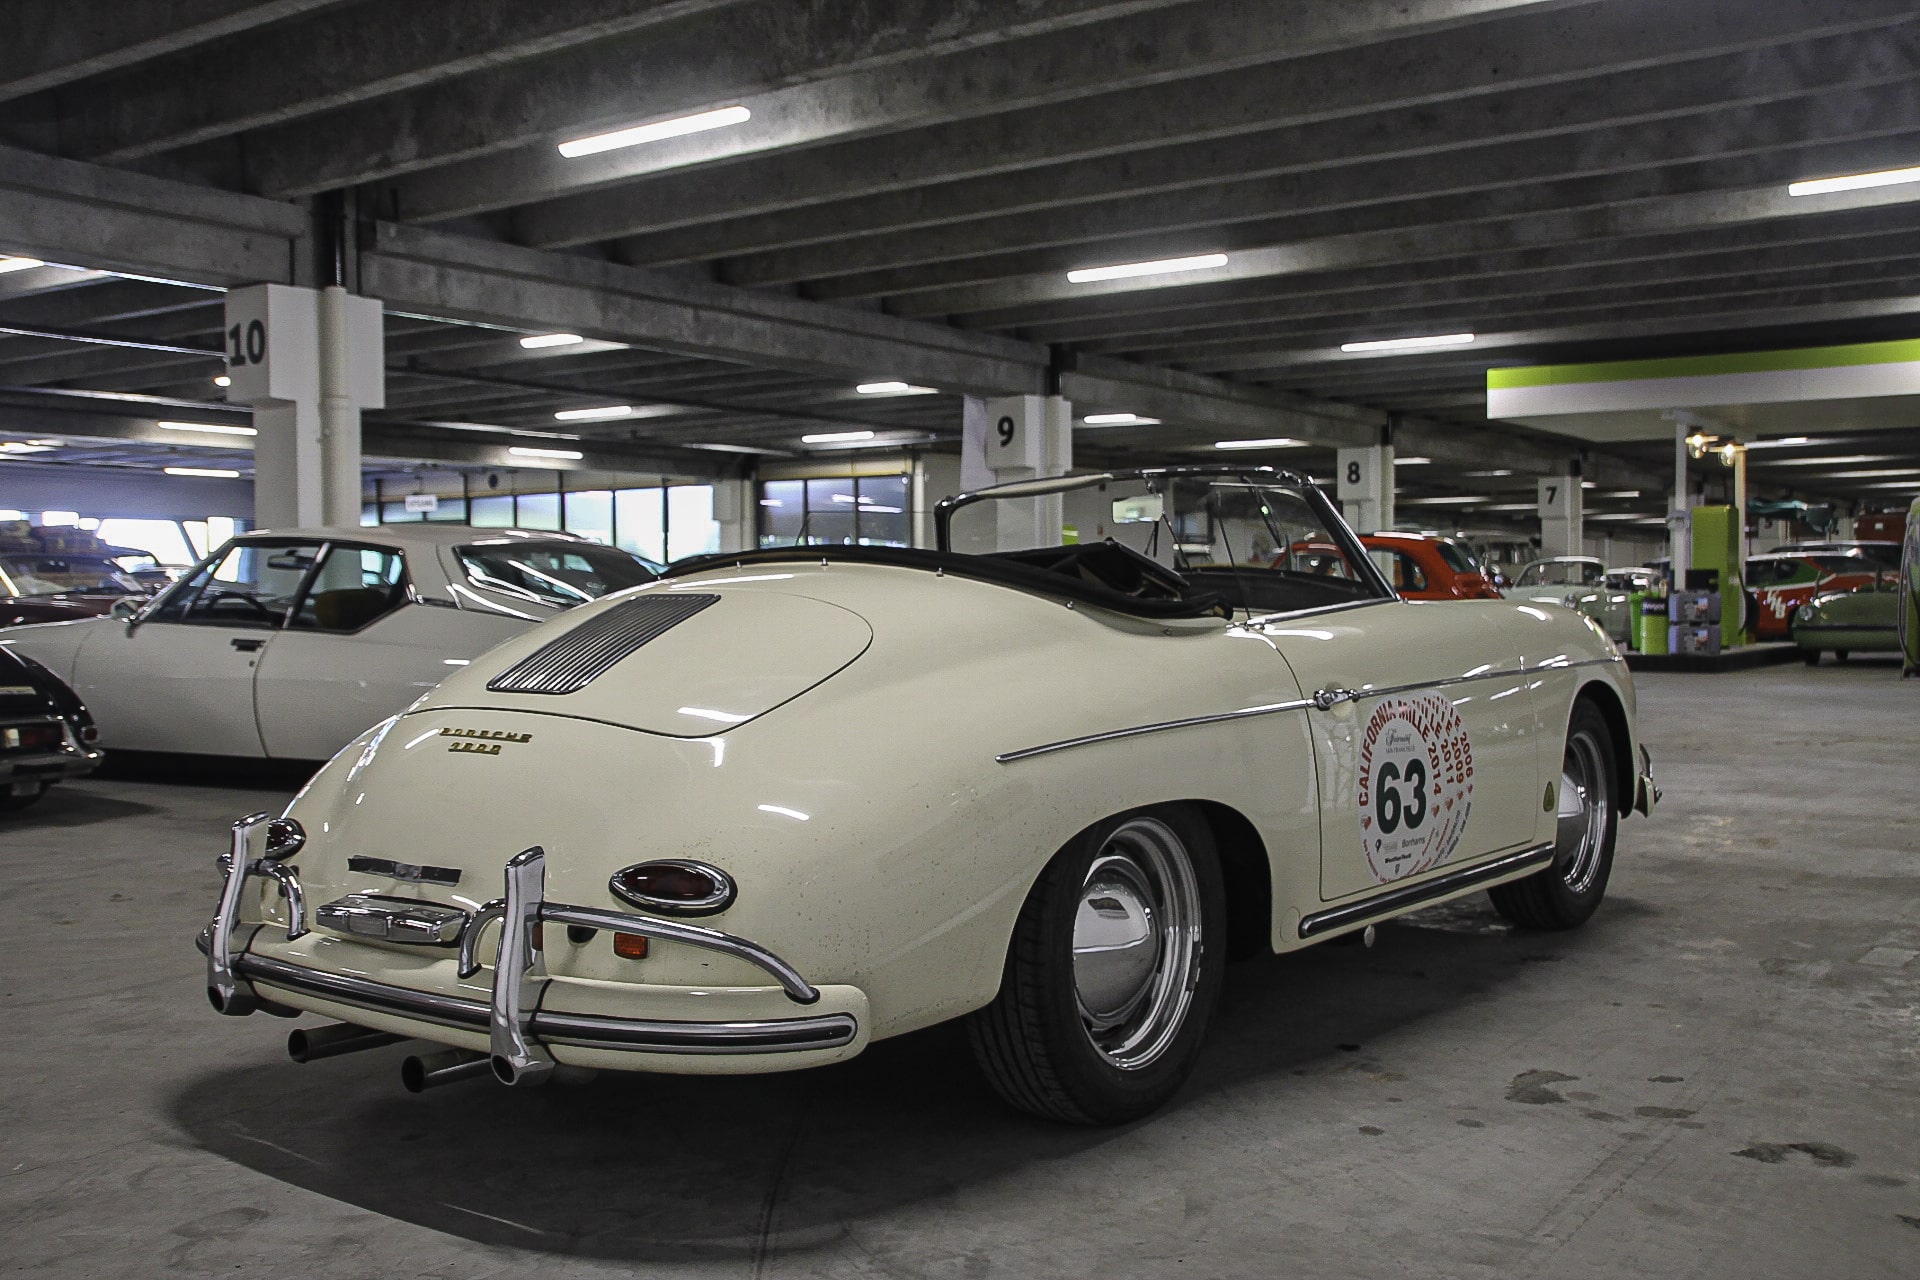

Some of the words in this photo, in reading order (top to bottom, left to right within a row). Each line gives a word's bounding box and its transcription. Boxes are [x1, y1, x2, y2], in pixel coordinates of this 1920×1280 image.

[228, 318, 266, 367] 10
[997, 415, 1014, 447] 9
[1346, 461, 1361, 484] 8
[1545, 486, 1557, 505] 7
[439, 727, 533, 744] PORSCHE
[1358, 700, 1397, 807] CALIFORNIA
[1397, 700, 1431, 743] MILLE
[1427, 741, 1442, 796] 2014
[1460, 731, 1474, 778] 2006
[1440, 738, 1455, 785] 2011
[1451, 736, 1465, 785] 2009
[1376, 758, 1427, 835] 63
